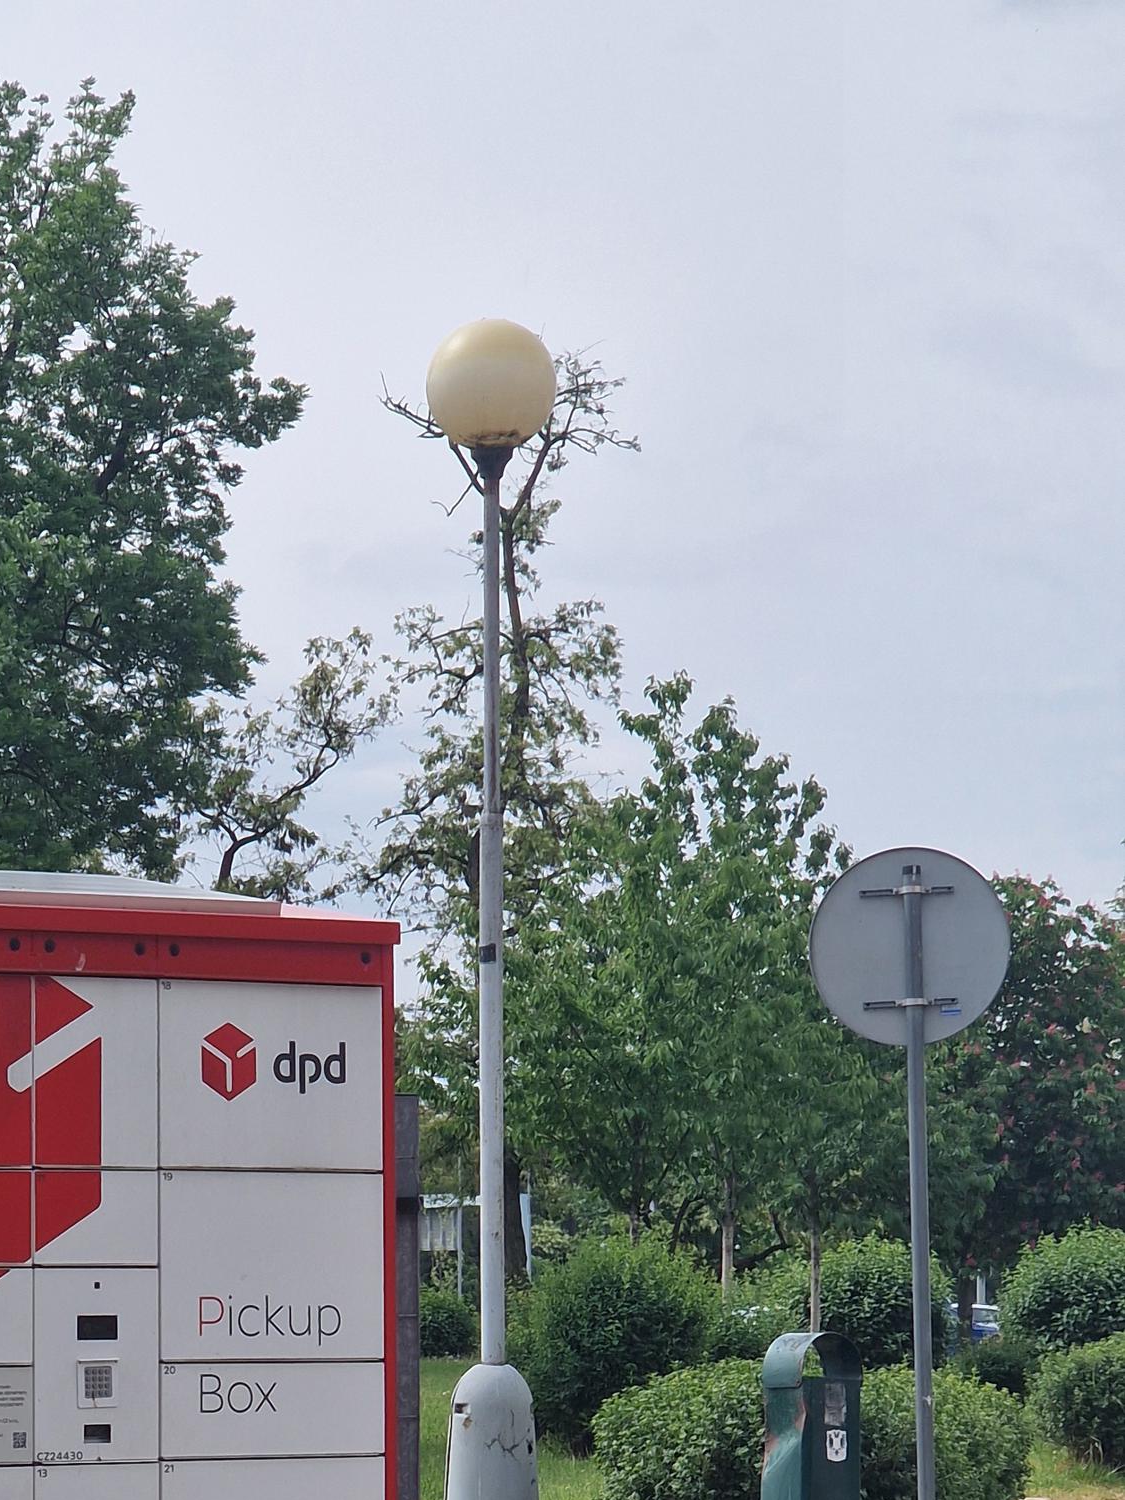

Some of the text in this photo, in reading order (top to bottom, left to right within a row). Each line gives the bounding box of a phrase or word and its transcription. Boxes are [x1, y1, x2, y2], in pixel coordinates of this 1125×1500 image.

[161, 981, 172, 990] 18
[273, 1041, 346, 1094] dpd
[163, 1172, 173, 1181] 19
[199, 1295, 341, 1346] Pickup
[164, 1366, 176, 1375] 20
[199, 1373, 277, 1413] Box
[36, 1451, 83, 1461] CZ24430
[164, 1464, 174, 1473] 21
[37, 1469, 48, 1478] 13
